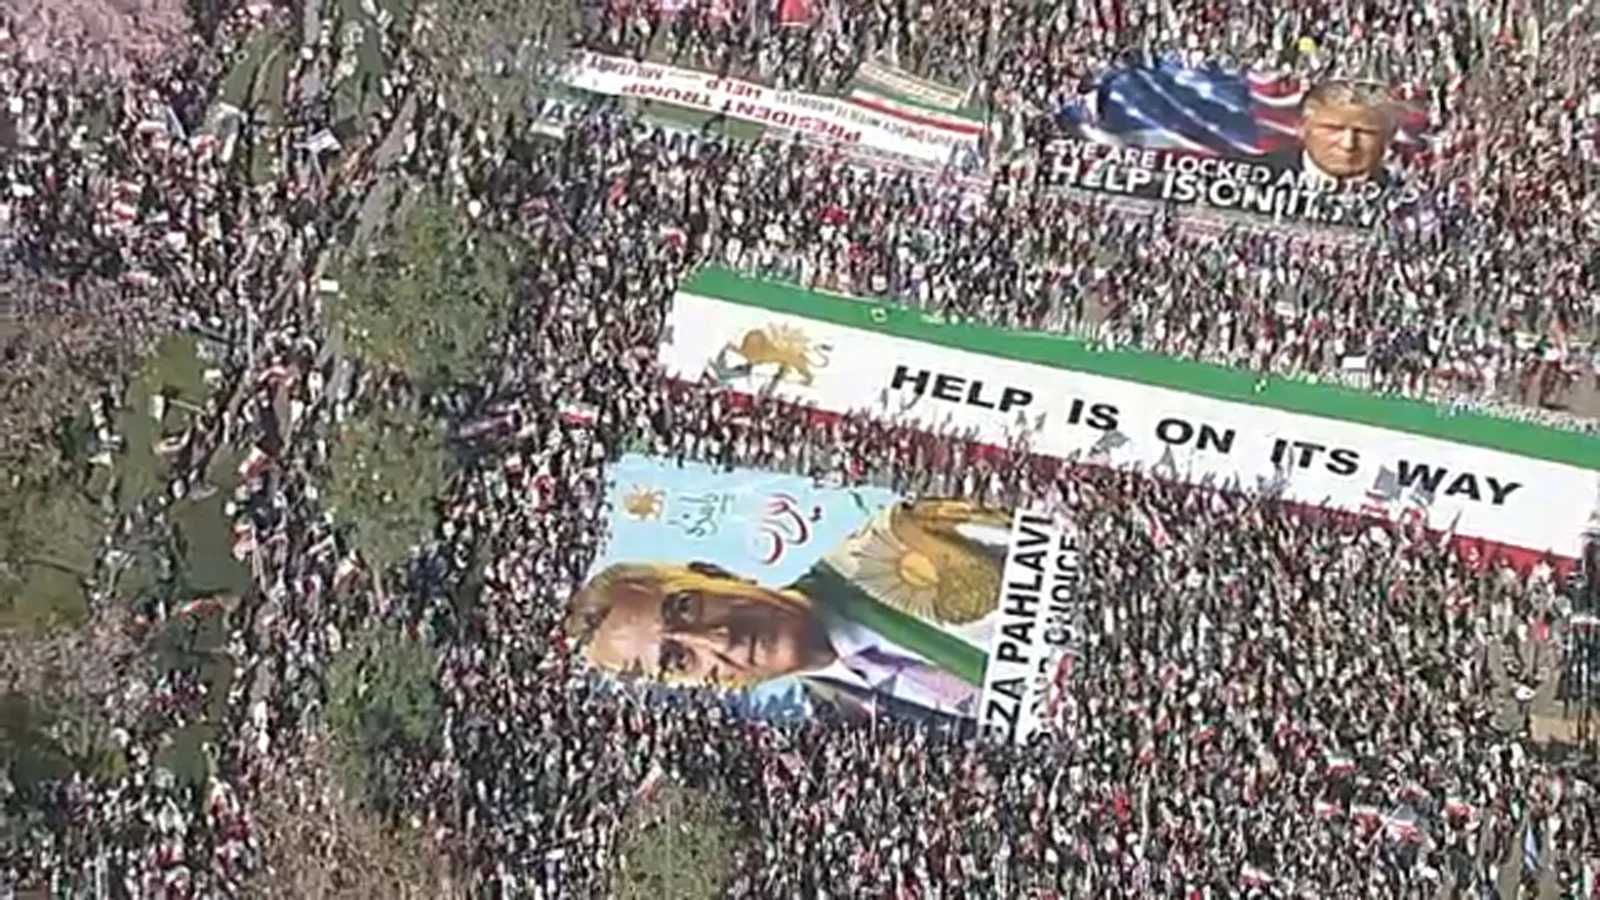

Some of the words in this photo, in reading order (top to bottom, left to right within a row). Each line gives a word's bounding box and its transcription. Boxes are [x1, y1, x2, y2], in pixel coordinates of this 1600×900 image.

[622, 83, 712, 107] TRUMP
[706, 79, 762, 101] HELP
[721, 98, 862, 143] PRESIDENT
[1106, 145, 1155, 168] ARE
[1164, 152, 1271, 183] LOCKED
[1276, 168, 1338, 193] AND
[1162, 171, 1197, 201] IS
[1209, 178, 1274, 212] ON
[891, 366, 1034, 412] HELP
[1067, 399, 1120, 431] IS
[1155, 418, 1237, 454] ON
[1270, 438, 1360, 476] ITS
[1398, 459, 1524, 506] WAY
[754, 492, 822, 565] ایران
[997, 515, 1053, 664] PAHLAVI
[983, 677, 1027, 747] EZA
